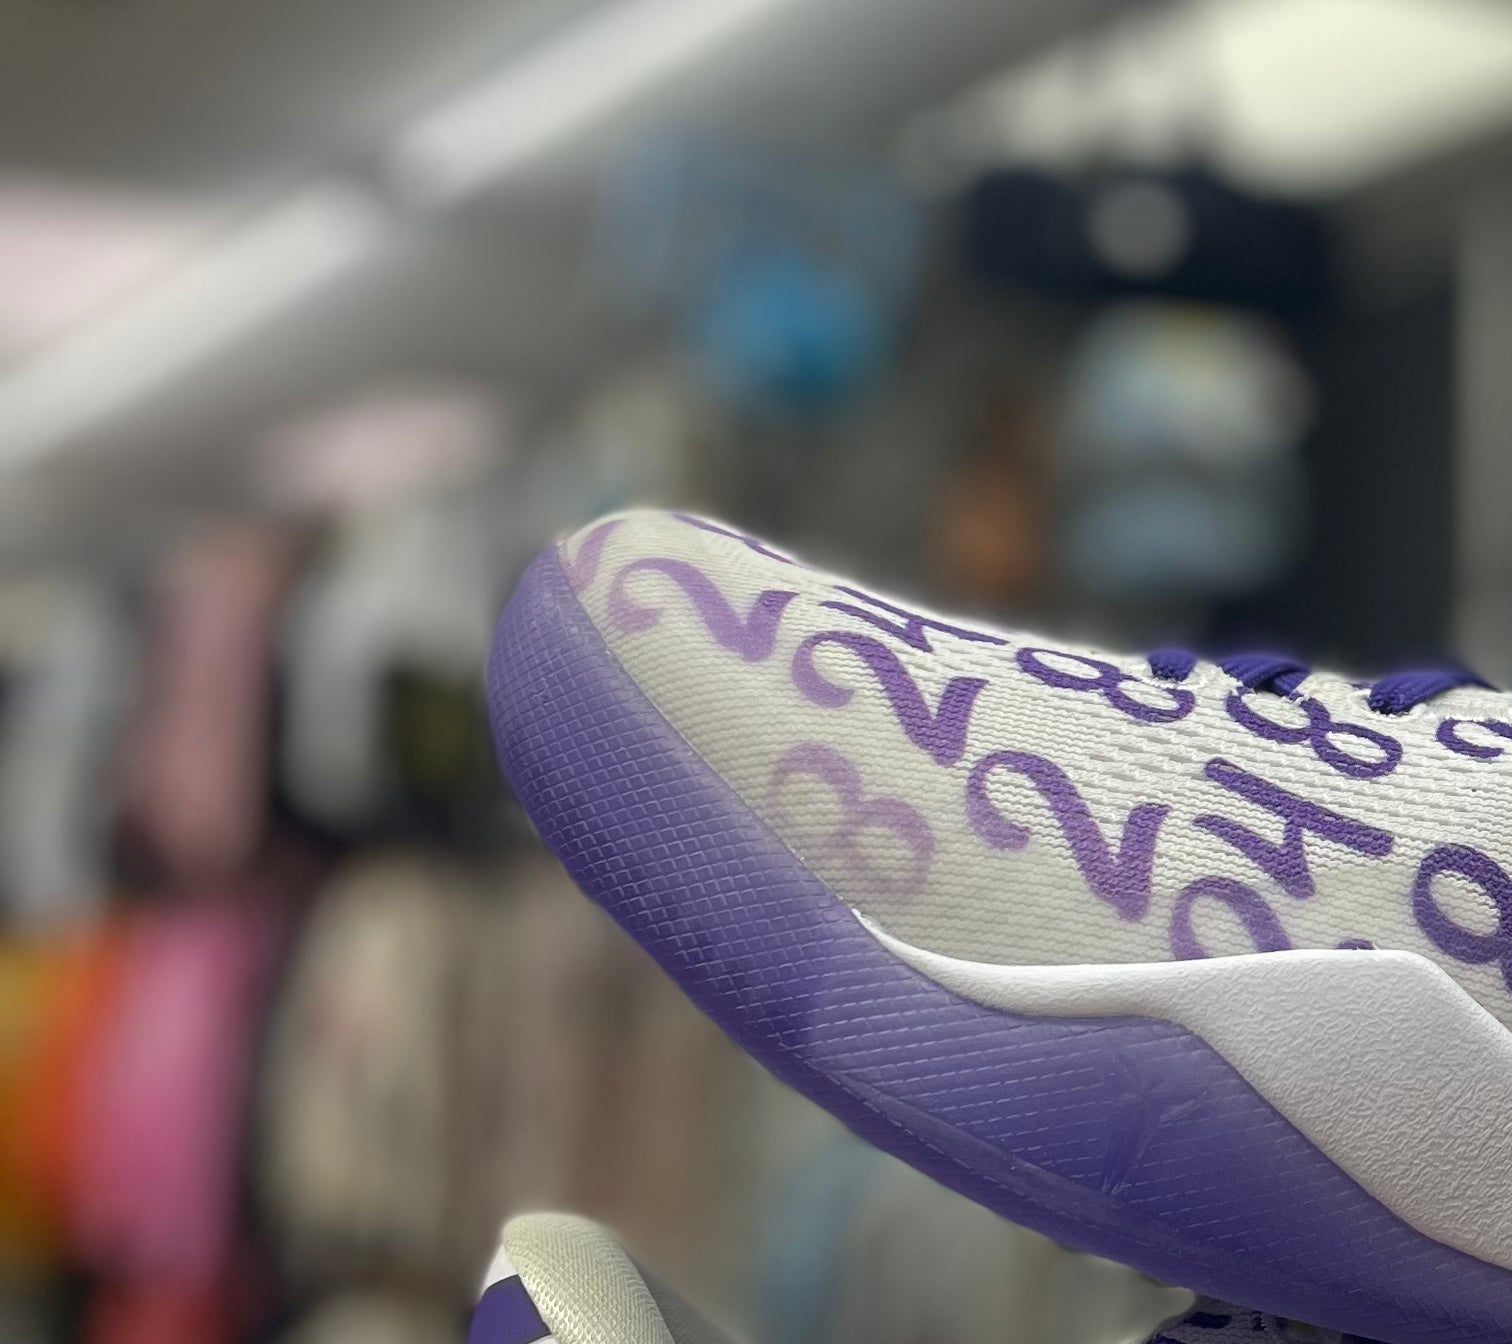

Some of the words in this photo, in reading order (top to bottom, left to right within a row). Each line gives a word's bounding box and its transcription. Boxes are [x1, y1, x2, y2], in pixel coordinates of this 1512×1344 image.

[1016, 645, 1196, 724] 8
[1225, 686, 1403, 778] 8
[765, 741, 936, 894] 8
[966, 749, 1170, 922] 2
